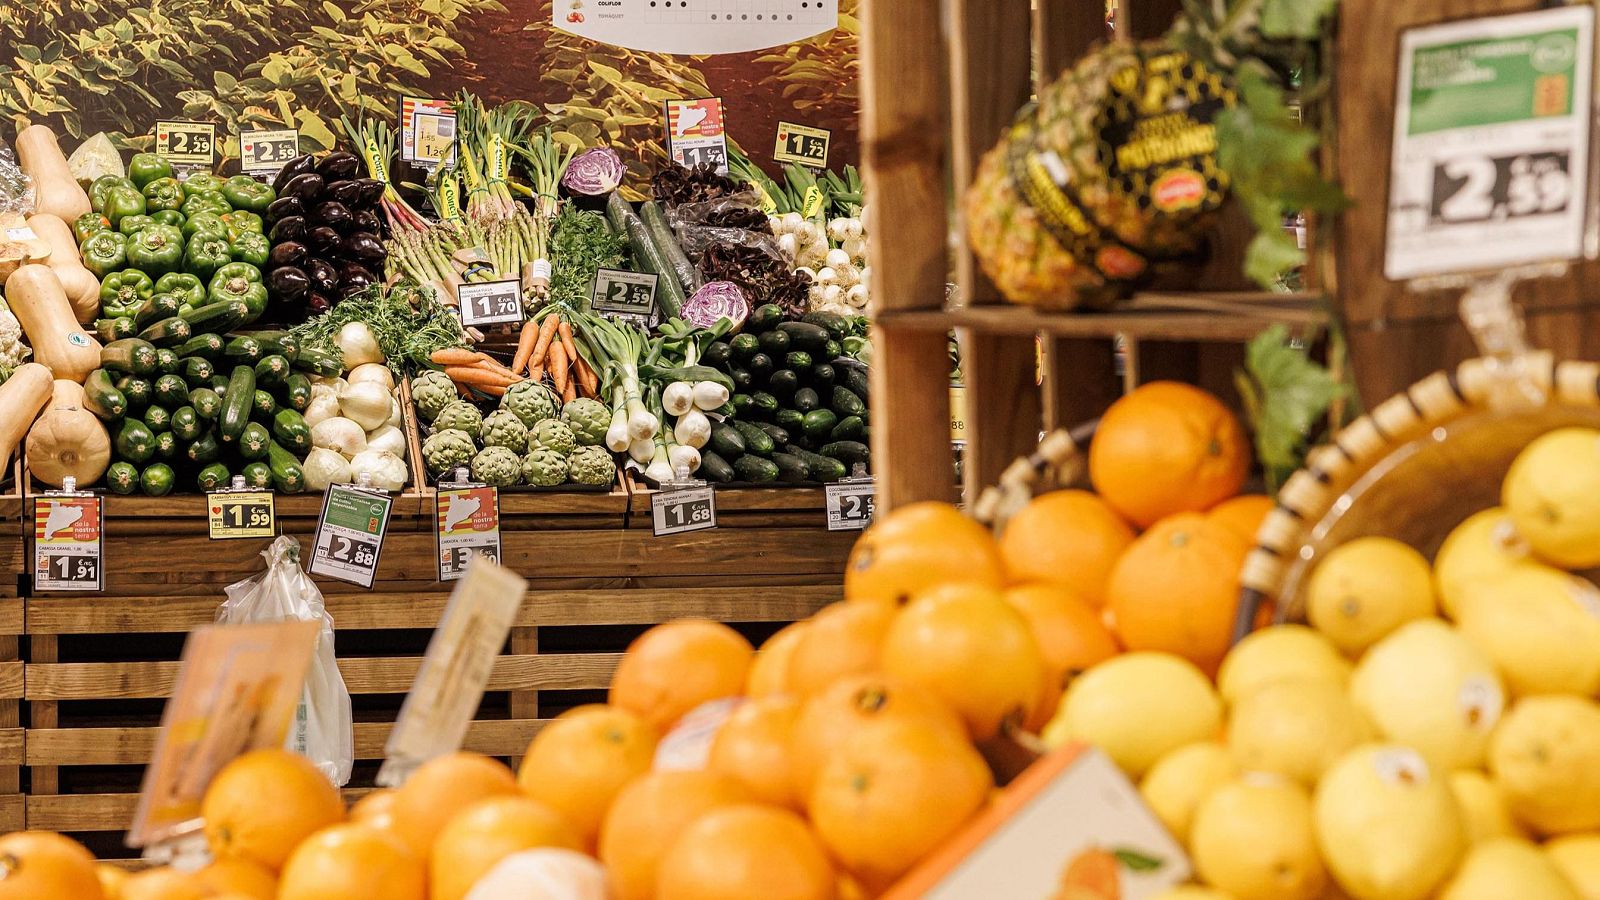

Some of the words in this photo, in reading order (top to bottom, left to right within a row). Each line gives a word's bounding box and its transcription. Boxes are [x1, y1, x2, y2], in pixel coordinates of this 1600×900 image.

[174, 132, 210, 154] 2,29
[258, 142, 296, 162] 2,59
[792, 135, 824, 157] 1,72
[1440, 155, 1569, 223] 2,59
[612, 282, 650, 304] 2,59
[477, 296, 516, 316] 1,70
[229, 505, 270, 528] 1,99
[671, 504, 710, 524] 1,68
[846, 496, 876, 519] 2,3
[334, 538, 374, 566] 2,88
[56, 556, 95, 580] 1,91
